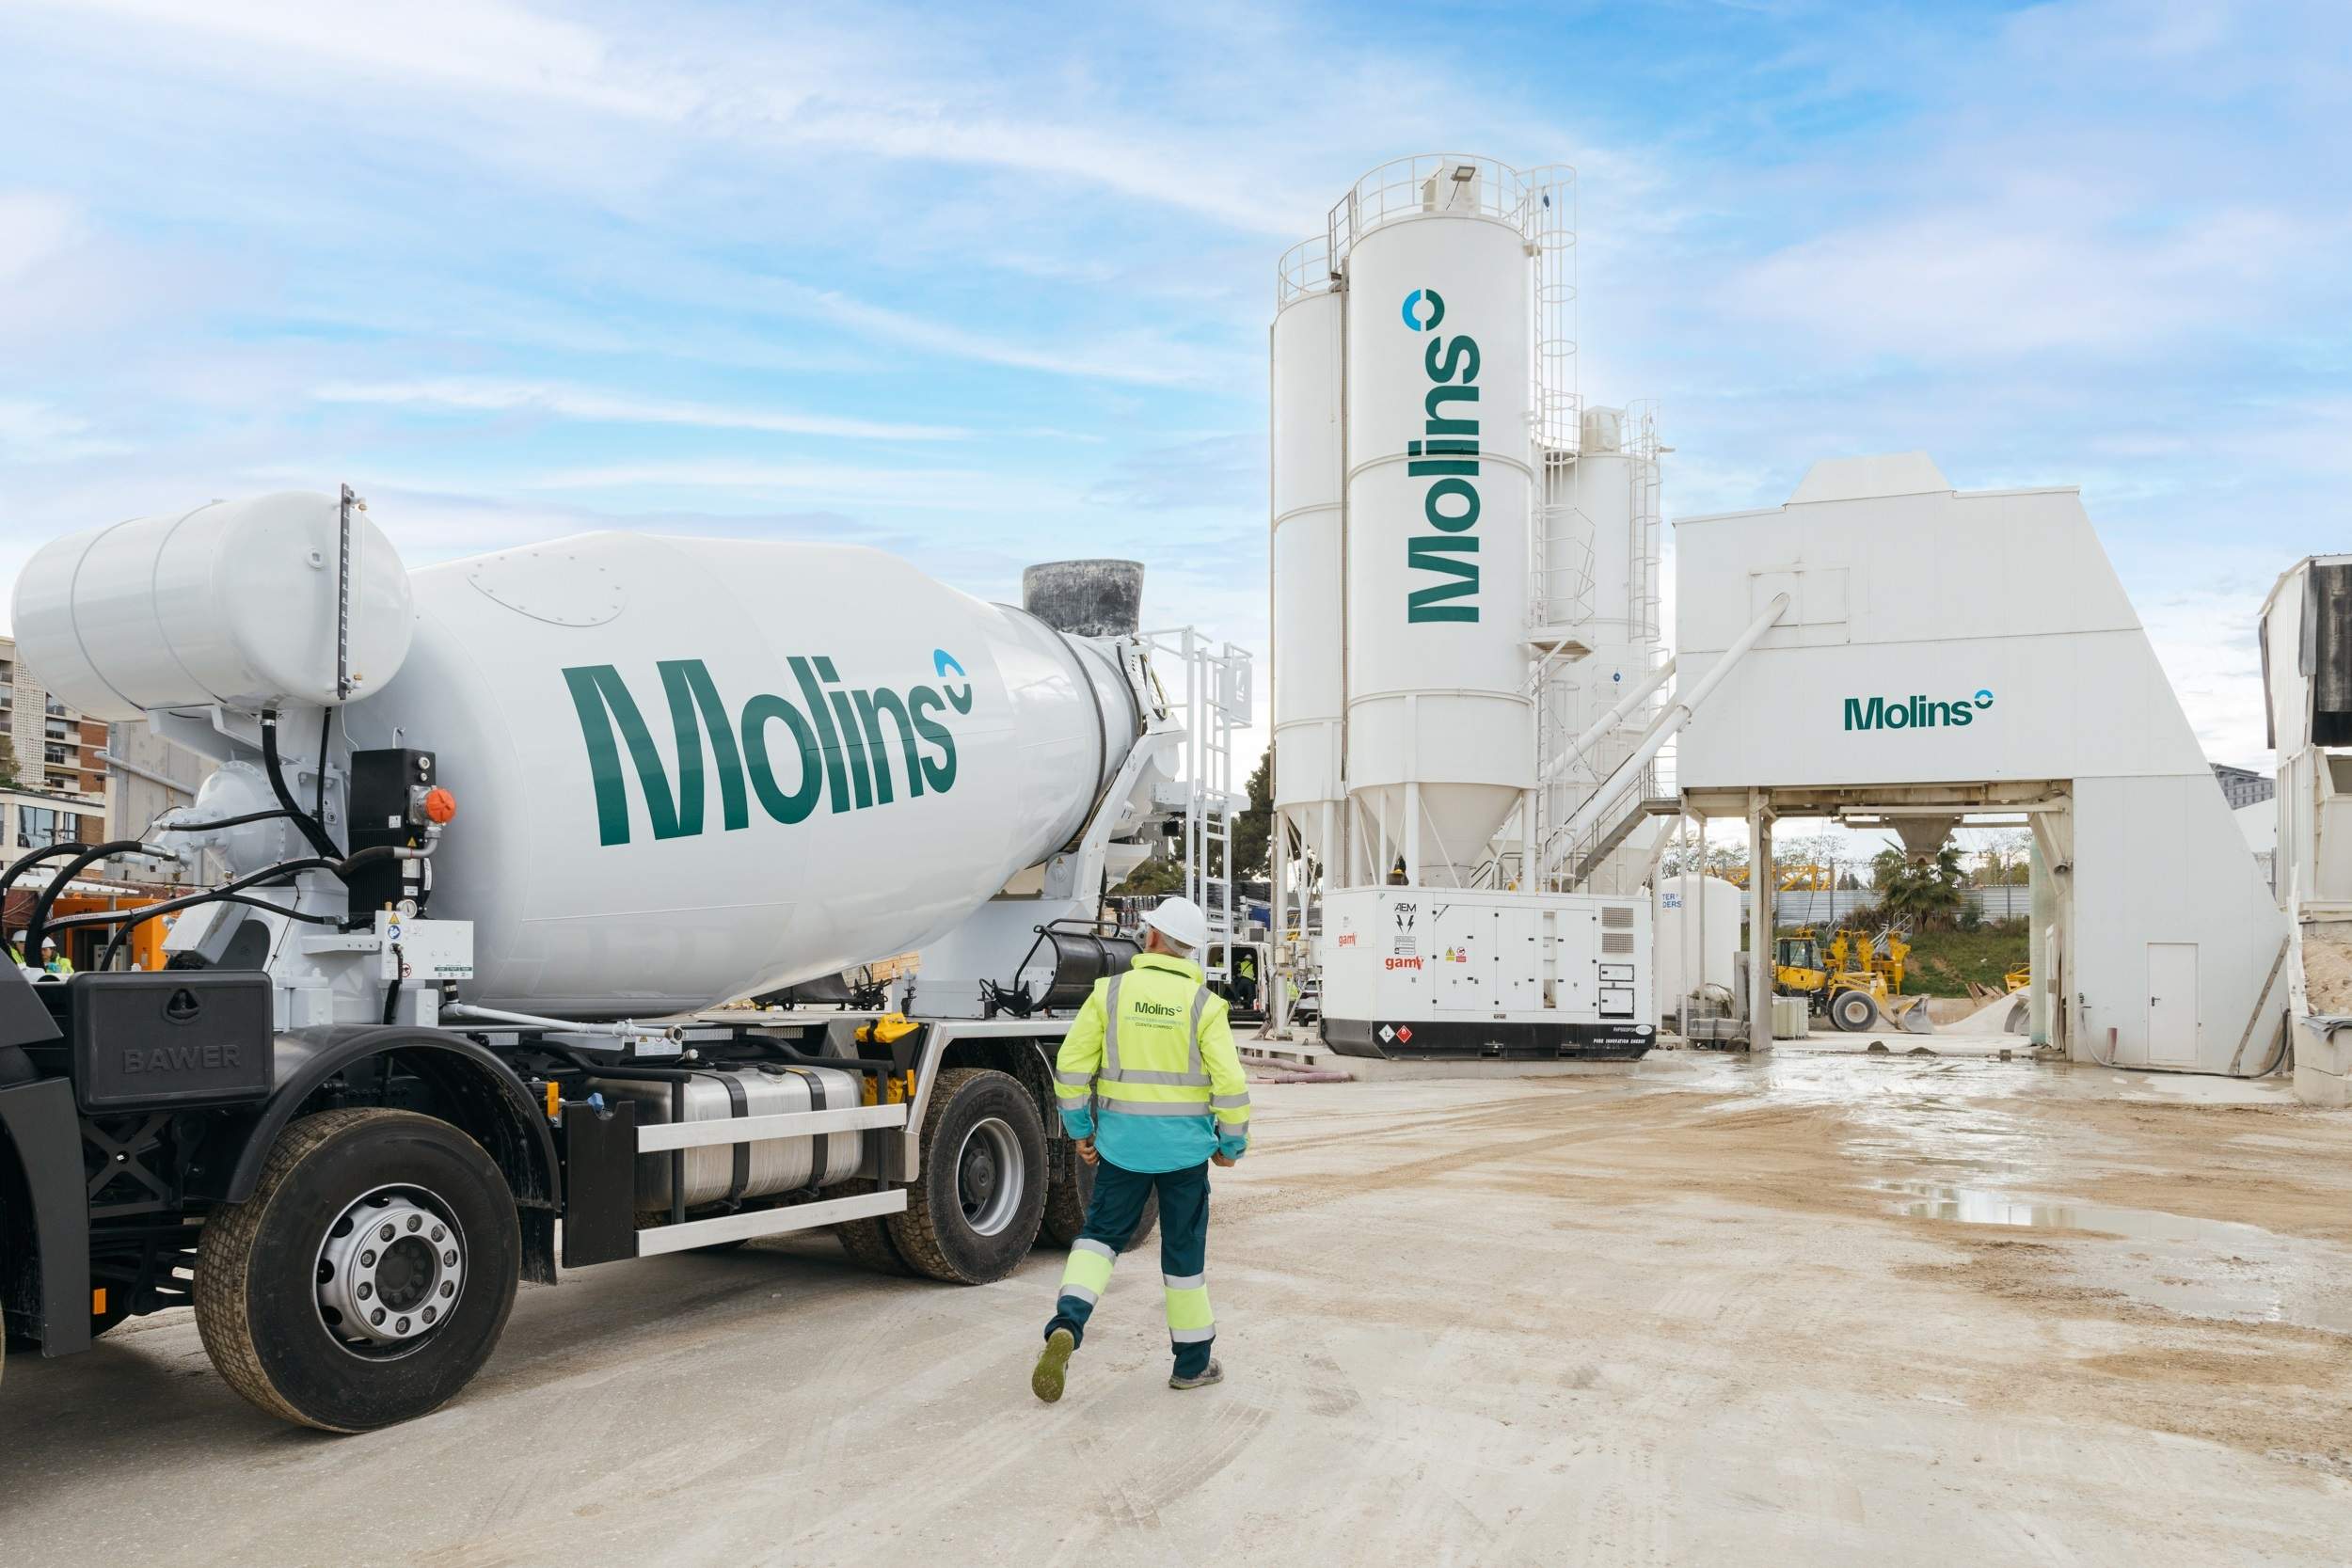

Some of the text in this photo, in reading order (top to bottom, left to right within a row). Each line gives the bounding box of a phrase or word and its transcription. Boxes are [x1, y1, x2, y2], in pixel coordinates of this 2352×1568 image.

[1407, 334, 1481, 624] Molins
[1844, 695, 1973, 731] Molins
[562, 656, 958, 847] Molins
[1394, 903, 1417, 912] AEM
[1135, 1002, 1175, 1017] Molins
[121, 1044, 241, 1074] BAWER
